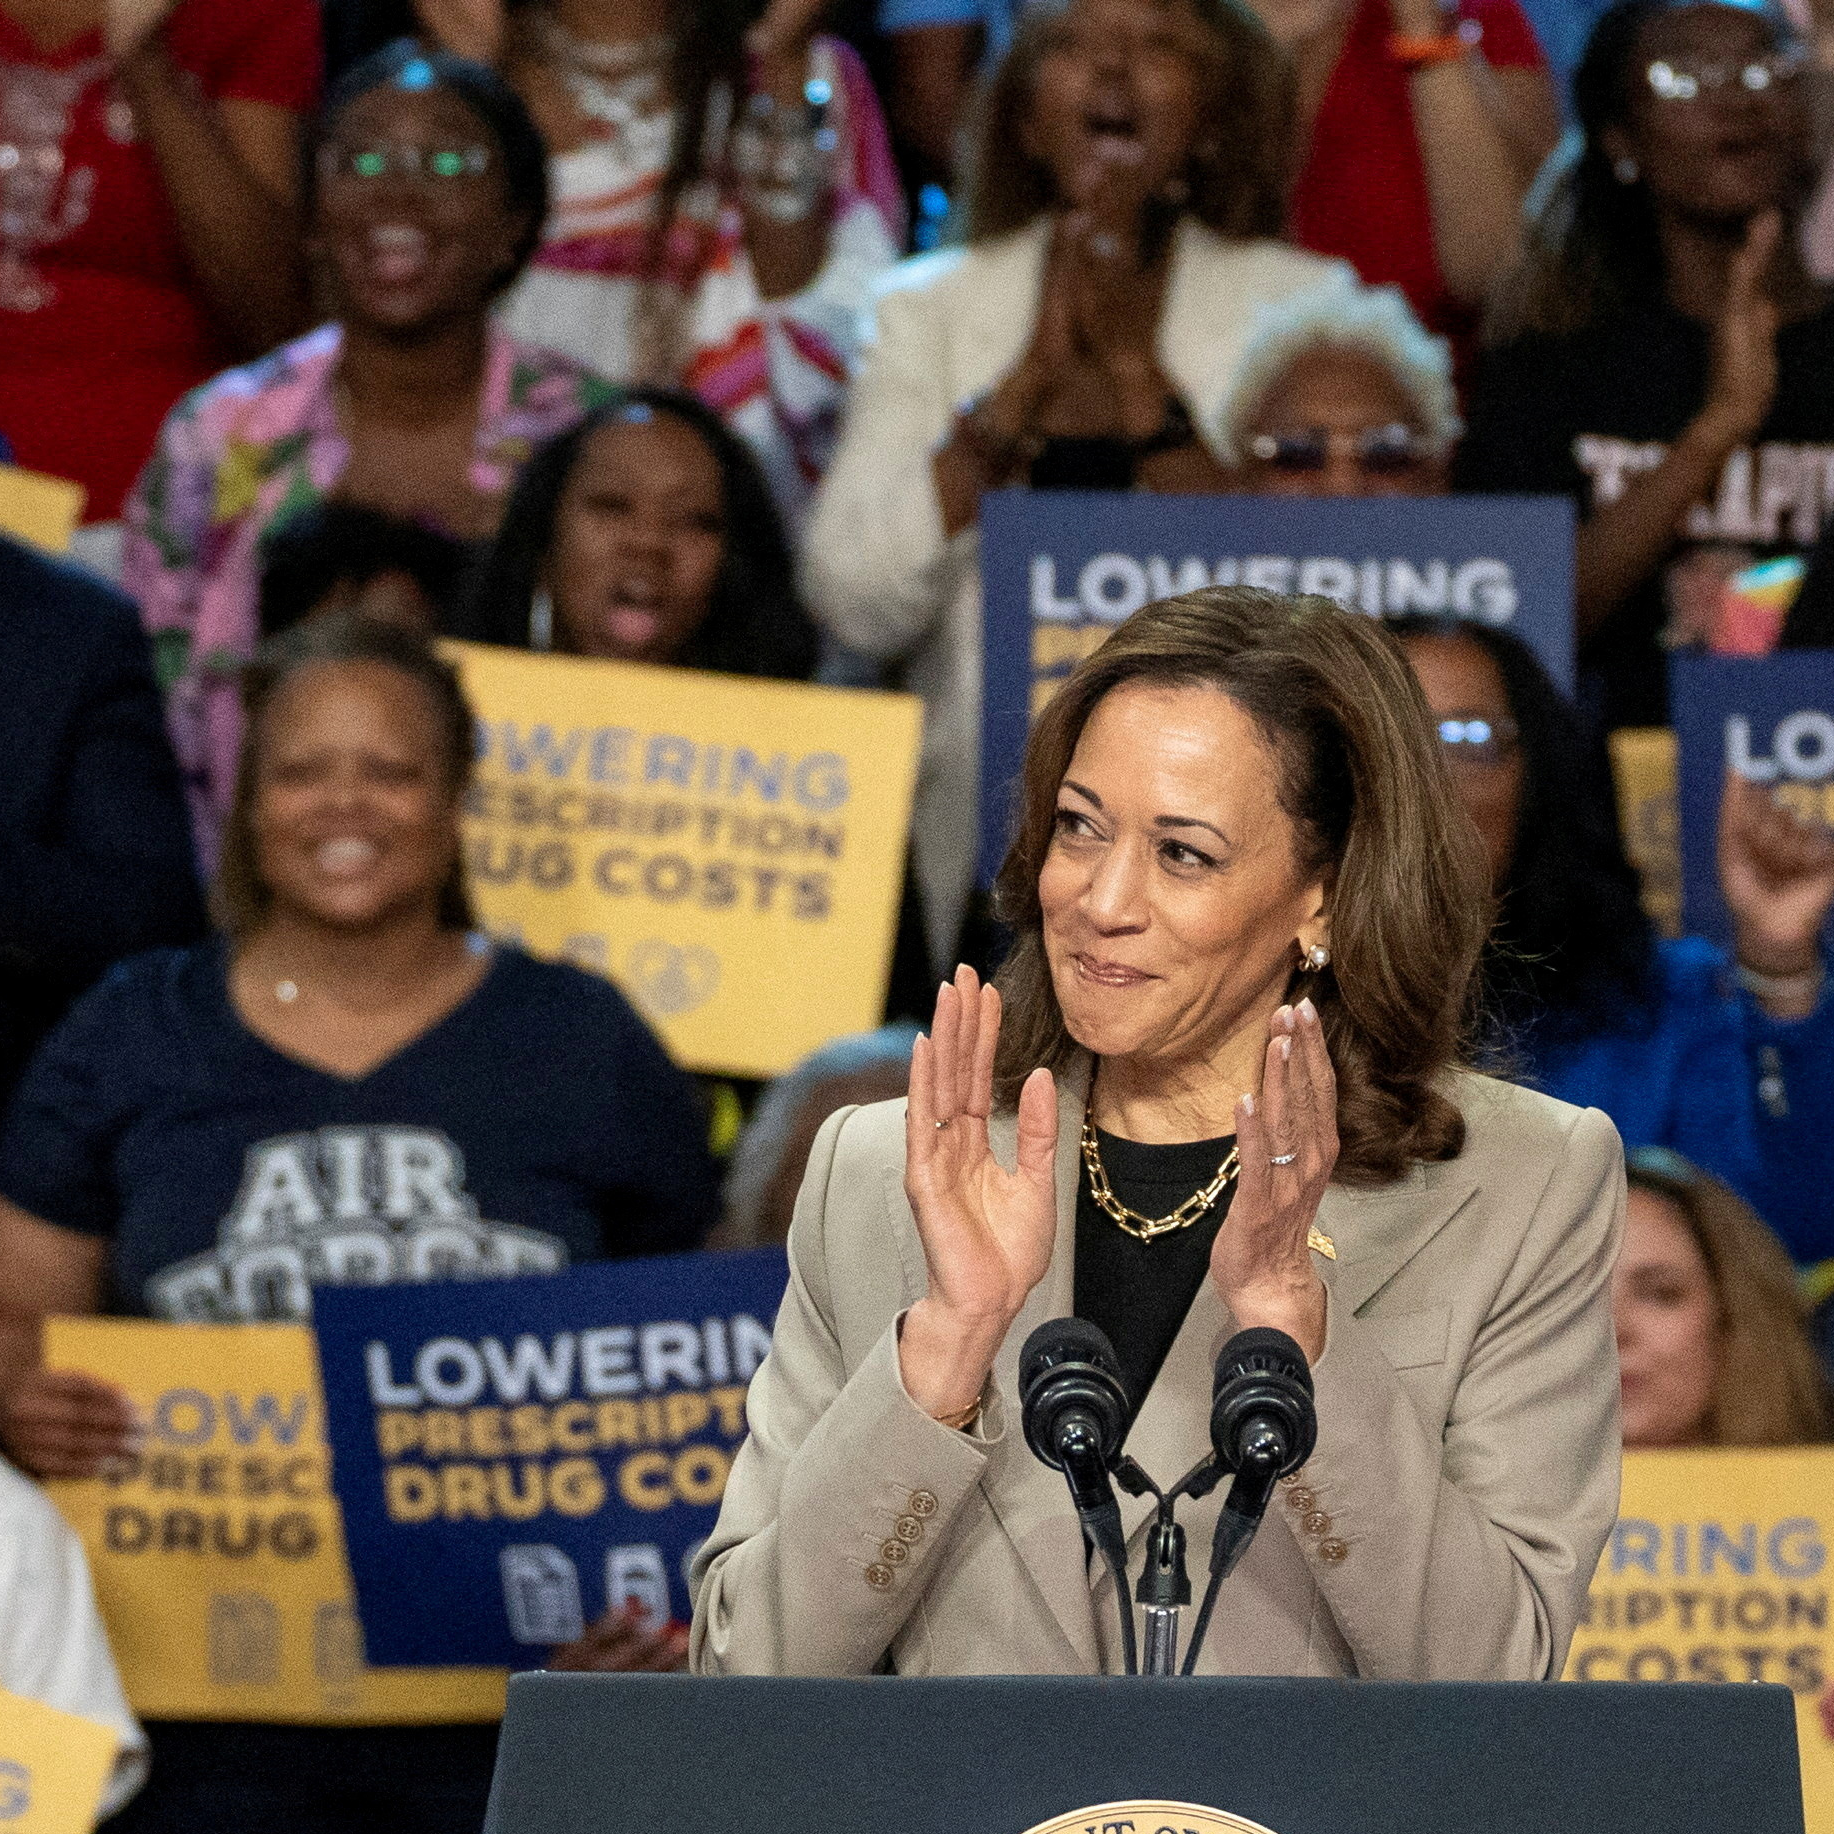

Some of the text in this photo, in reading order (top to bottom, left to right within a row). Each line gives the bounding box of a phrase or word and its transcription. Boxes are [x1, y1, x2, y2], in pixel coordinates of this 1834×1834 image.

[593, 847, 835, 924] COSTS
[233, 1128, 465, 1240] AIR
[376, 1386, 749, 1459] PRESCRIPT
[384, 1454, 607, 1523] DRUG
[104, 1504, 320, 1563] DRUG
